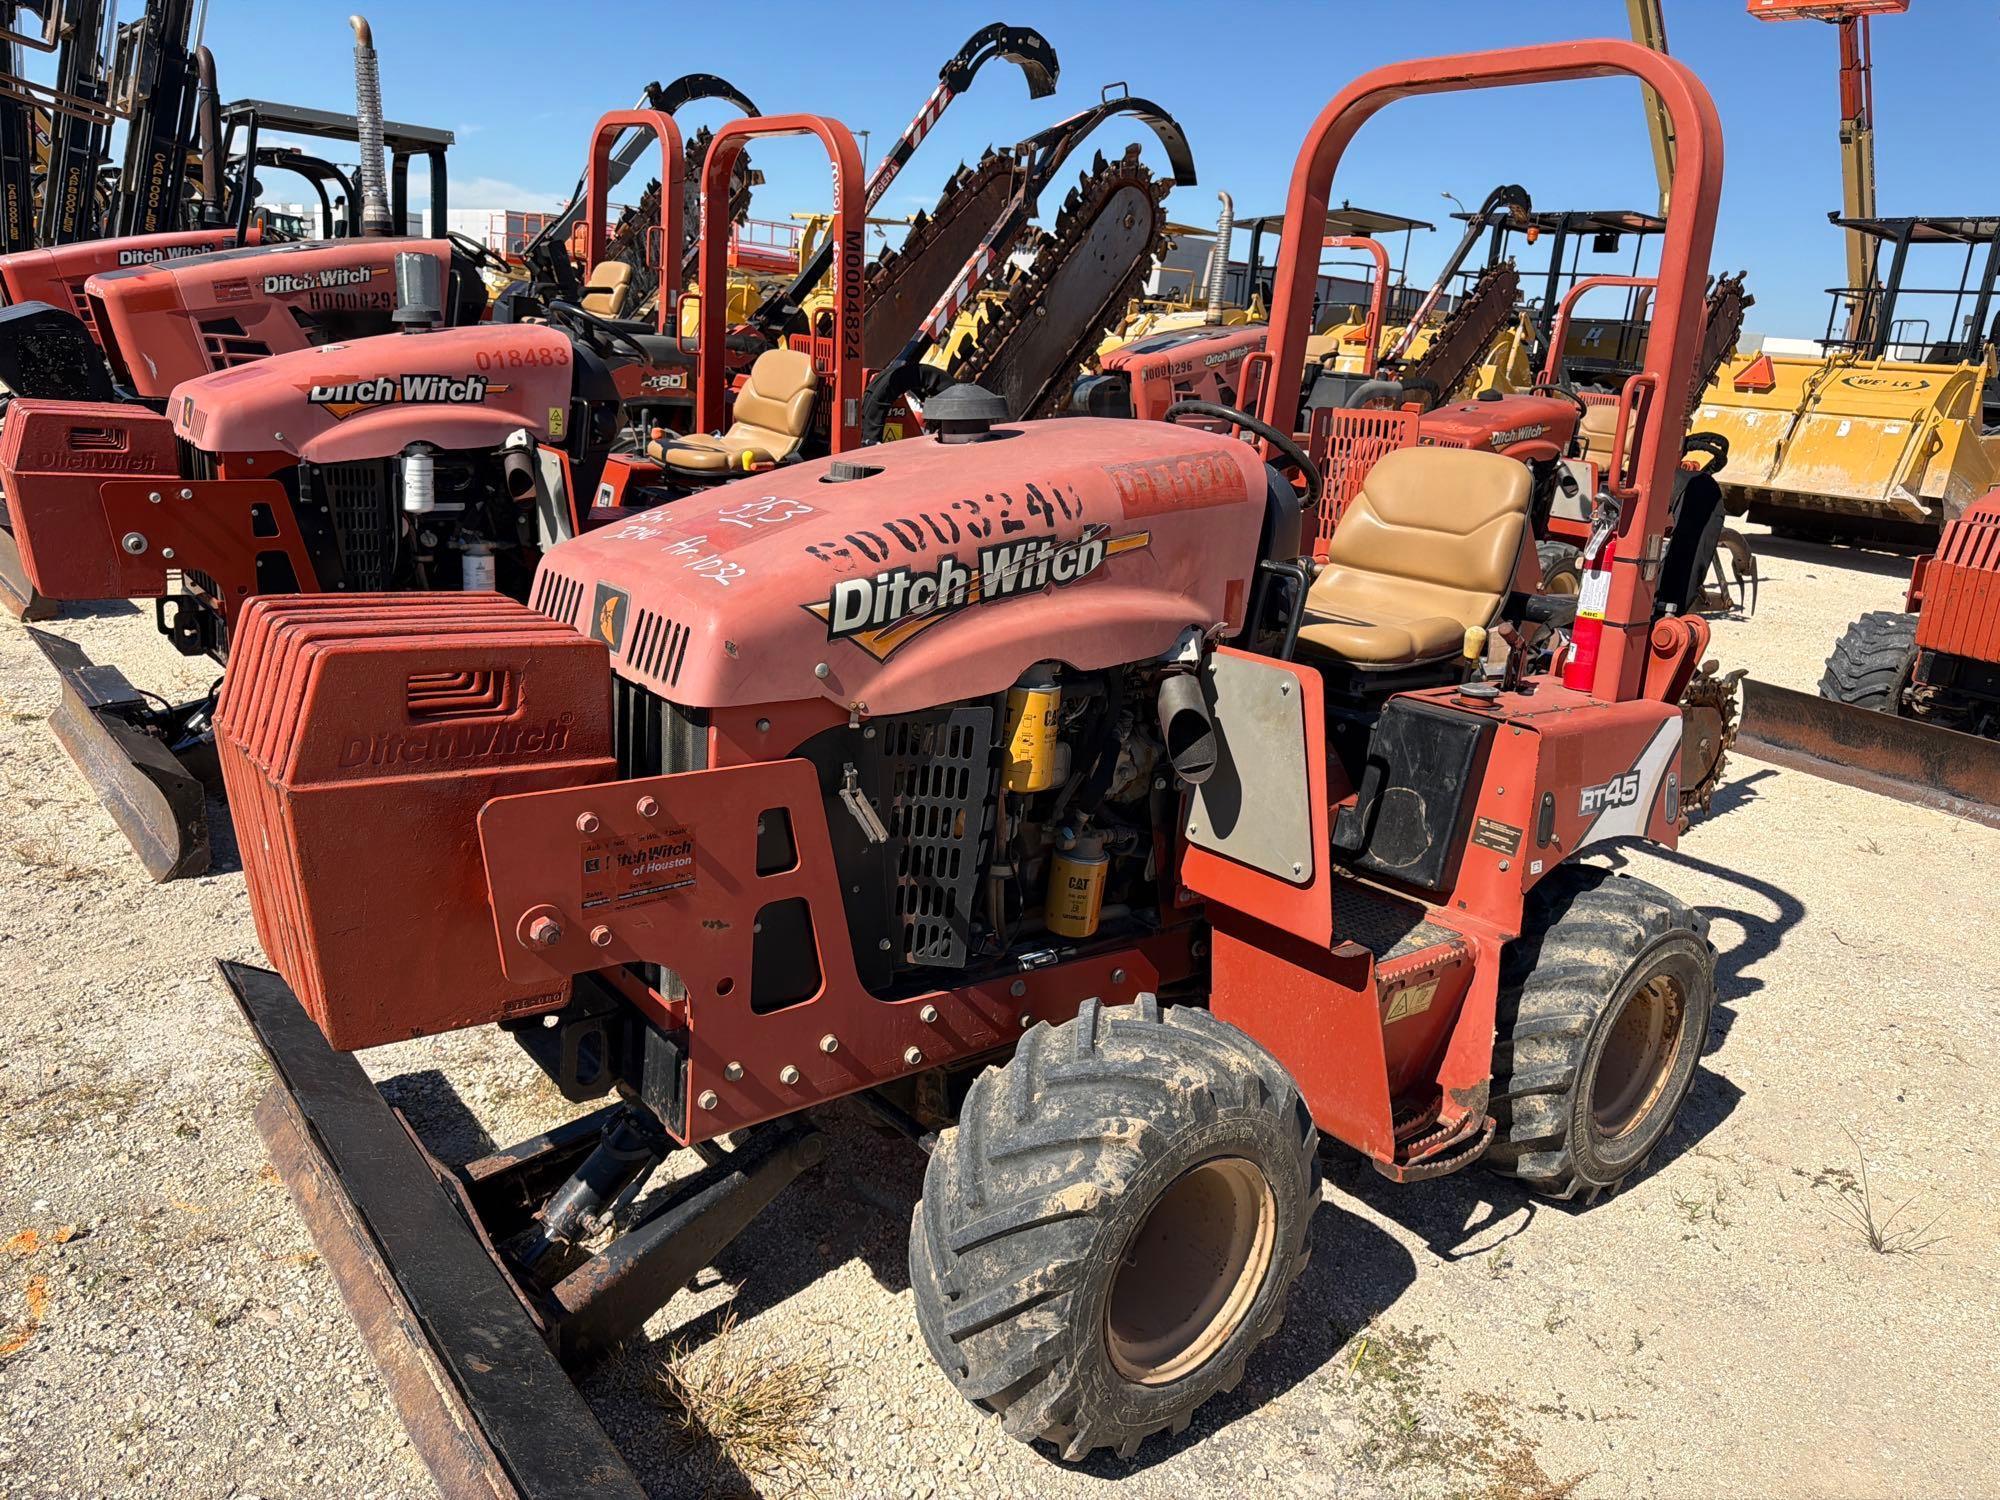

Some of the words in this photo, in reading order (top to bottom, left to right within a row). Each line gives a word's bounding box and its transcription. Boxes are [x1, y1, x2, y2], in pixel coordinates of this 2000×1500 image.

[119, 249, 164, 265] Ditch
[264, 274, 315, 293] Ditch
[319, 266, 370, 287] Witch
[845, 230, 861, 361] M0004824
[475, 347, 569, 371] 018483
[402, 375, 485, 402] Witch
[1491, 428, 1517, 446] Ditch
[1517, 424, 1543, 442] Witch
[833, 559, 967, 633] Ditch
[980, 530, 1105, 599] Witch
[340, 727, 453, 768] Ditch
[453, 720, 569, 758] Witch
[1581, 774, 1638, 811] RT45
[649, 840, 692, 861] Witch
[632, 867, 644, 876] of
[646, 857, 692, 873] Houston
[1068, 876, 1090, 891] CAT
